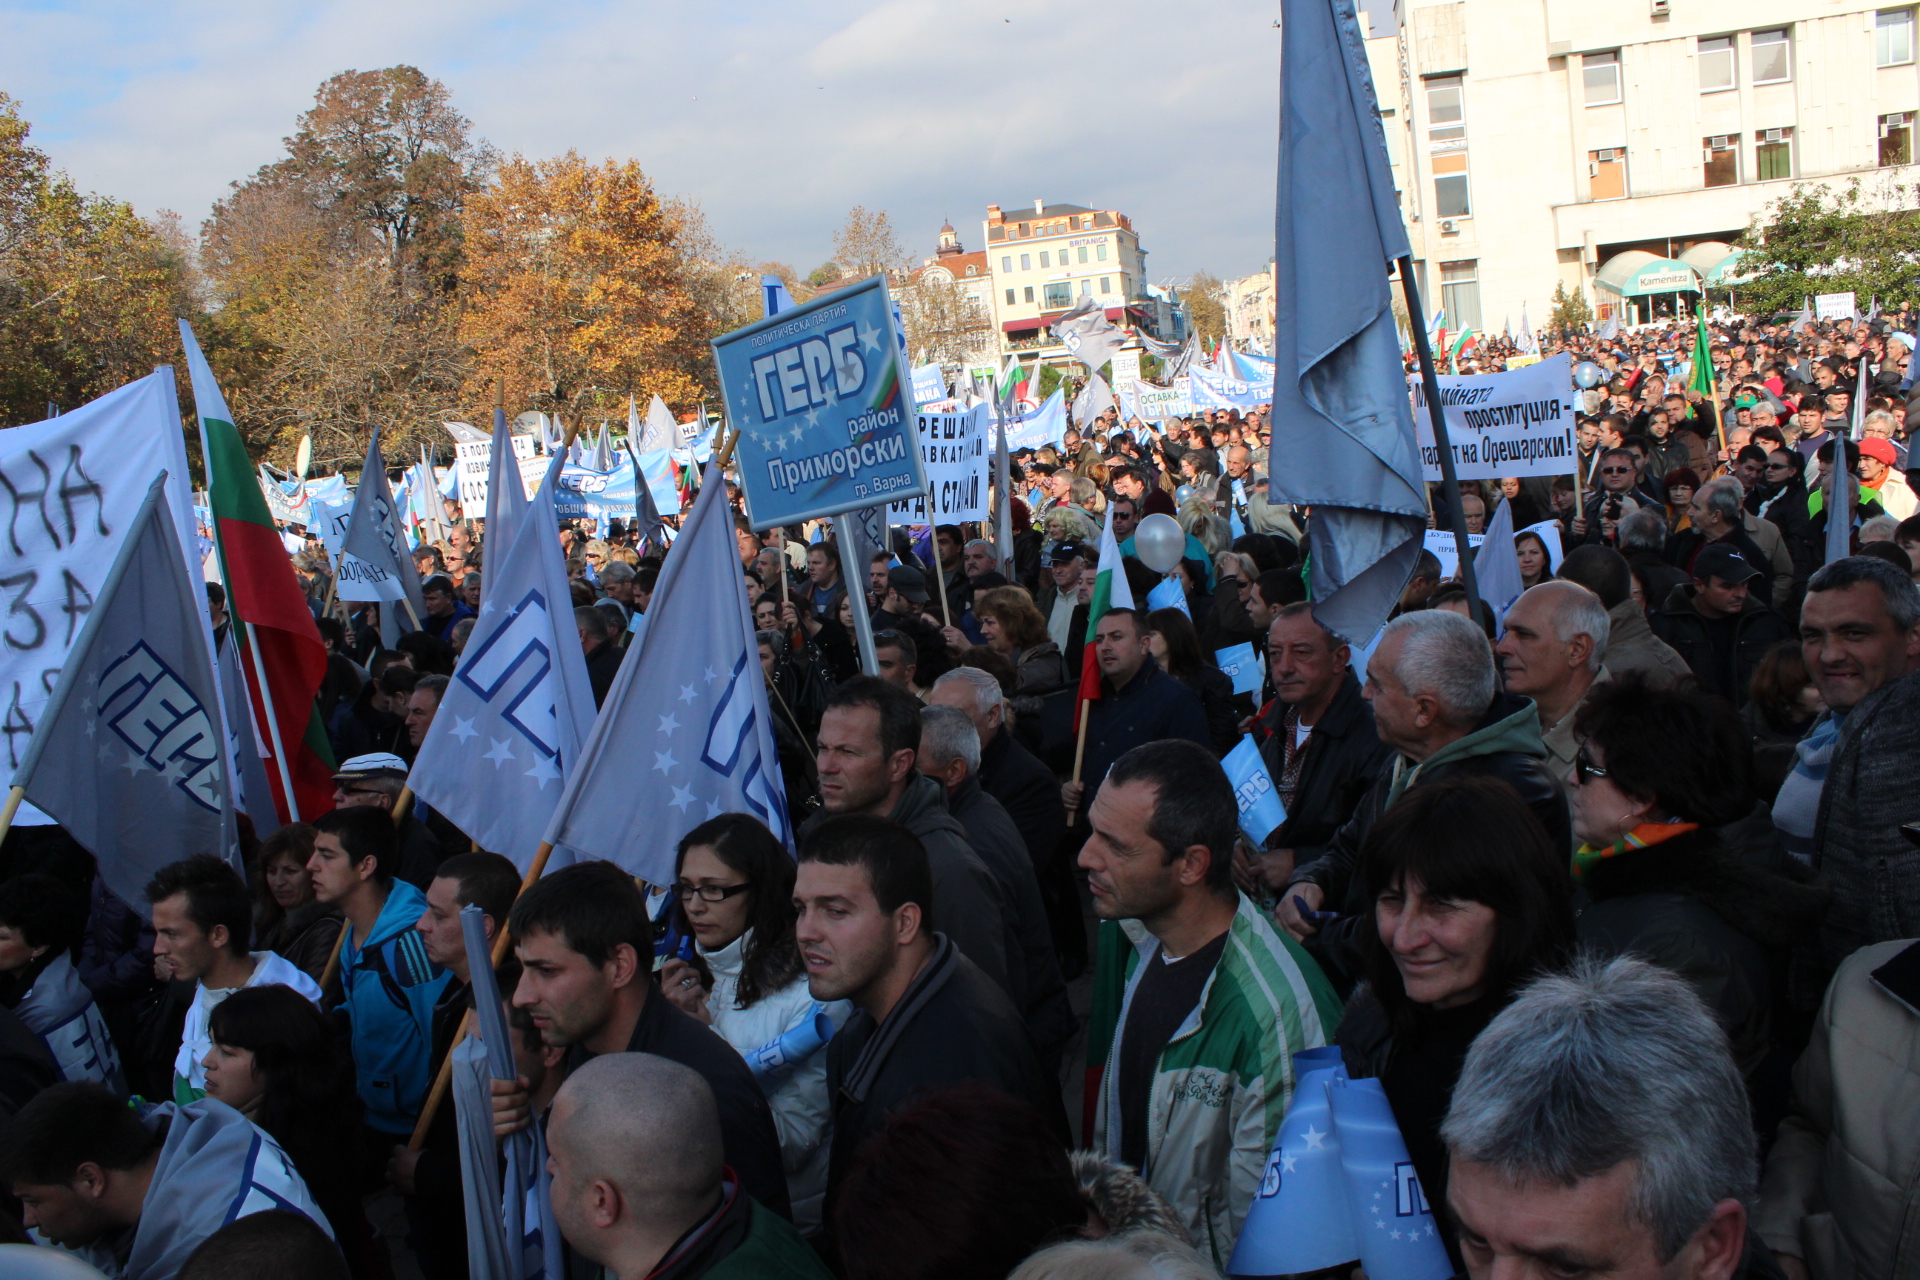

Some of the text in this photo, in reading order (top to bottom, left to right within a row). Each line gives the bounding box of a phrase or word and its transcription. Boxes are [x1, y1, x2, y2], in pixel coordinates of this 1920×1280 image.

[1070, 236, 1109, 247] BRITANICA
[1640, 275, 1688, 287] Kamenitza
[751, 304, 847, 349] ПОЛИТИЧЕСКА ПАРТИЯ
[750, 321, 867, 424] ГЕРБ
[1113, 359, 1139, 372] ГЕРБ
[1175, 379, 1190, 391] ОСТ
[1252, 387, 1274, 401] ТЪР
[1141, 391, 1180, 406] ОСТАВКА
[682, 425, 697, 436] НА
[848, 407, 900, 440] район
[1464, 399, 1560, 444] проституция
[1016, 432, 1049, 447] ОБЛАСТ
[1461, 443, 1478, 464] на
[1482, 428, 1572, 468] Орешарски!
[767, 434, 906, 494] Приморски
[558, 475, 610, 494] ГЕРБ
[854, 472, 912, 498] гр. Варна
[0, 444, 109, 556] НА
[557, 502, 601, 515] ОБЩИНА
[0, 568, 94, 652] ЗА
[1237, 769, 1271, 819] ЕРБ
